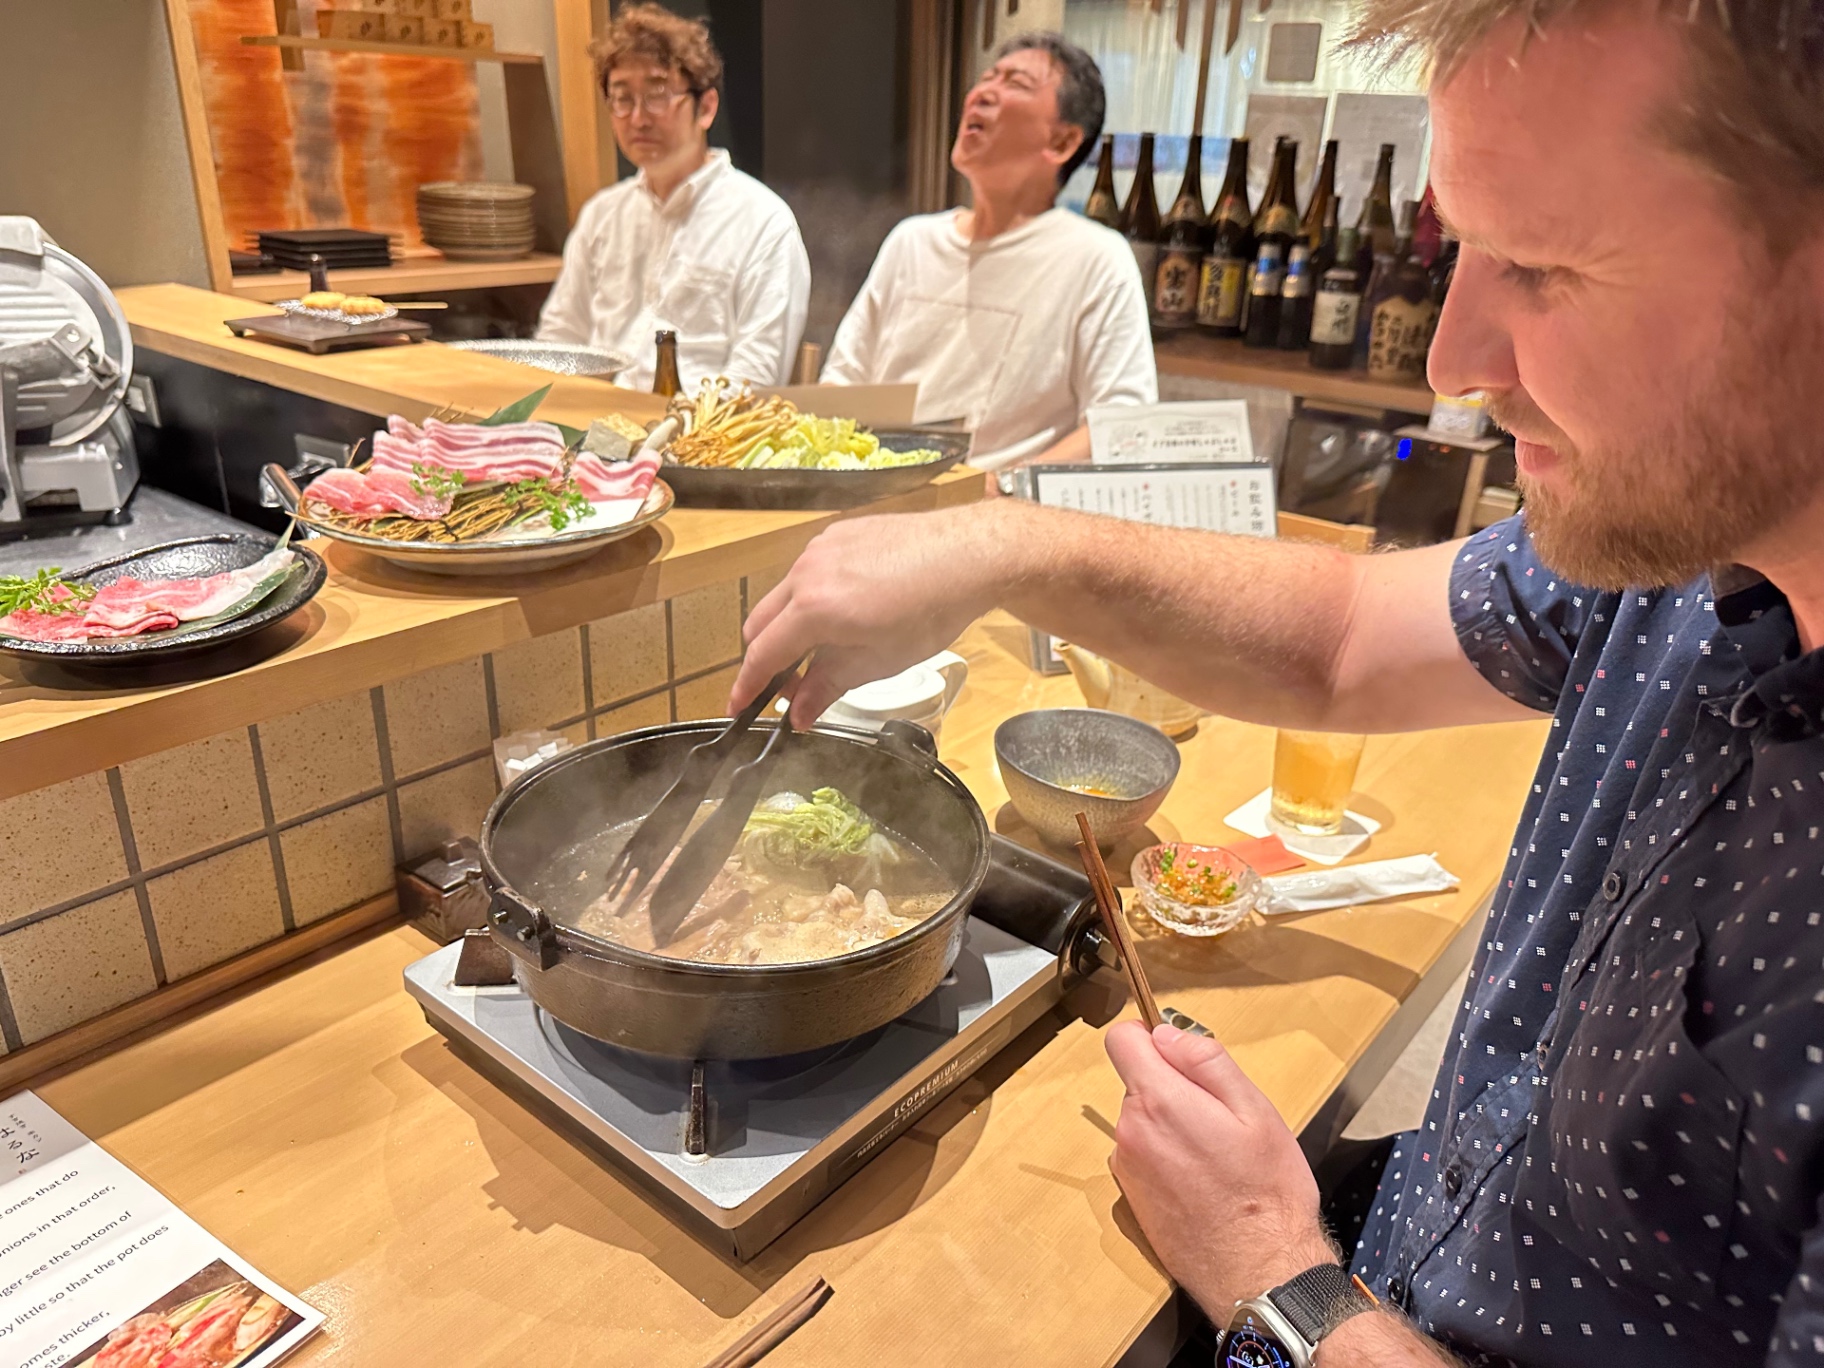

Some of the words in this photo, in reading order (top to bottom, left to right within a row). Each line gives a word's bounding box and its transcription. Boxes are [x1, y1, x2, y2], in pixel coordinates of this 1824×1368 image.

[894, 1060, 959, 1118] ECOPREMIUM
[0, 1231, 37, 1258] nions
[36, 1222, 51, 1233] in
[51, 1206, 79, 1224] that
[79, 1185, 116, 1208] order,
[4, 1195, 35, 1215] ones
[35, 1180, 62, 1196] that
[62, 1170, 79, 1182] do
[0, 1278, 22, 1297] ger
[25, 1264, 48, 1281] see
[48, 1250, 72, 1265] the
[71, 1221, 118, 1251] bottom
[119, 1210, 132, 1222] of
[14, 1302, 48, 1325] little
[48, 1292, 65, 1304] so
[65, 1273, 94, 1293] that
[93, 1259, 116, 1275] the
[117, 1244, 140, 1261] pot
[139, 1225, 169, 1246] does
[58, 1311, 110, 1344] thicker,
